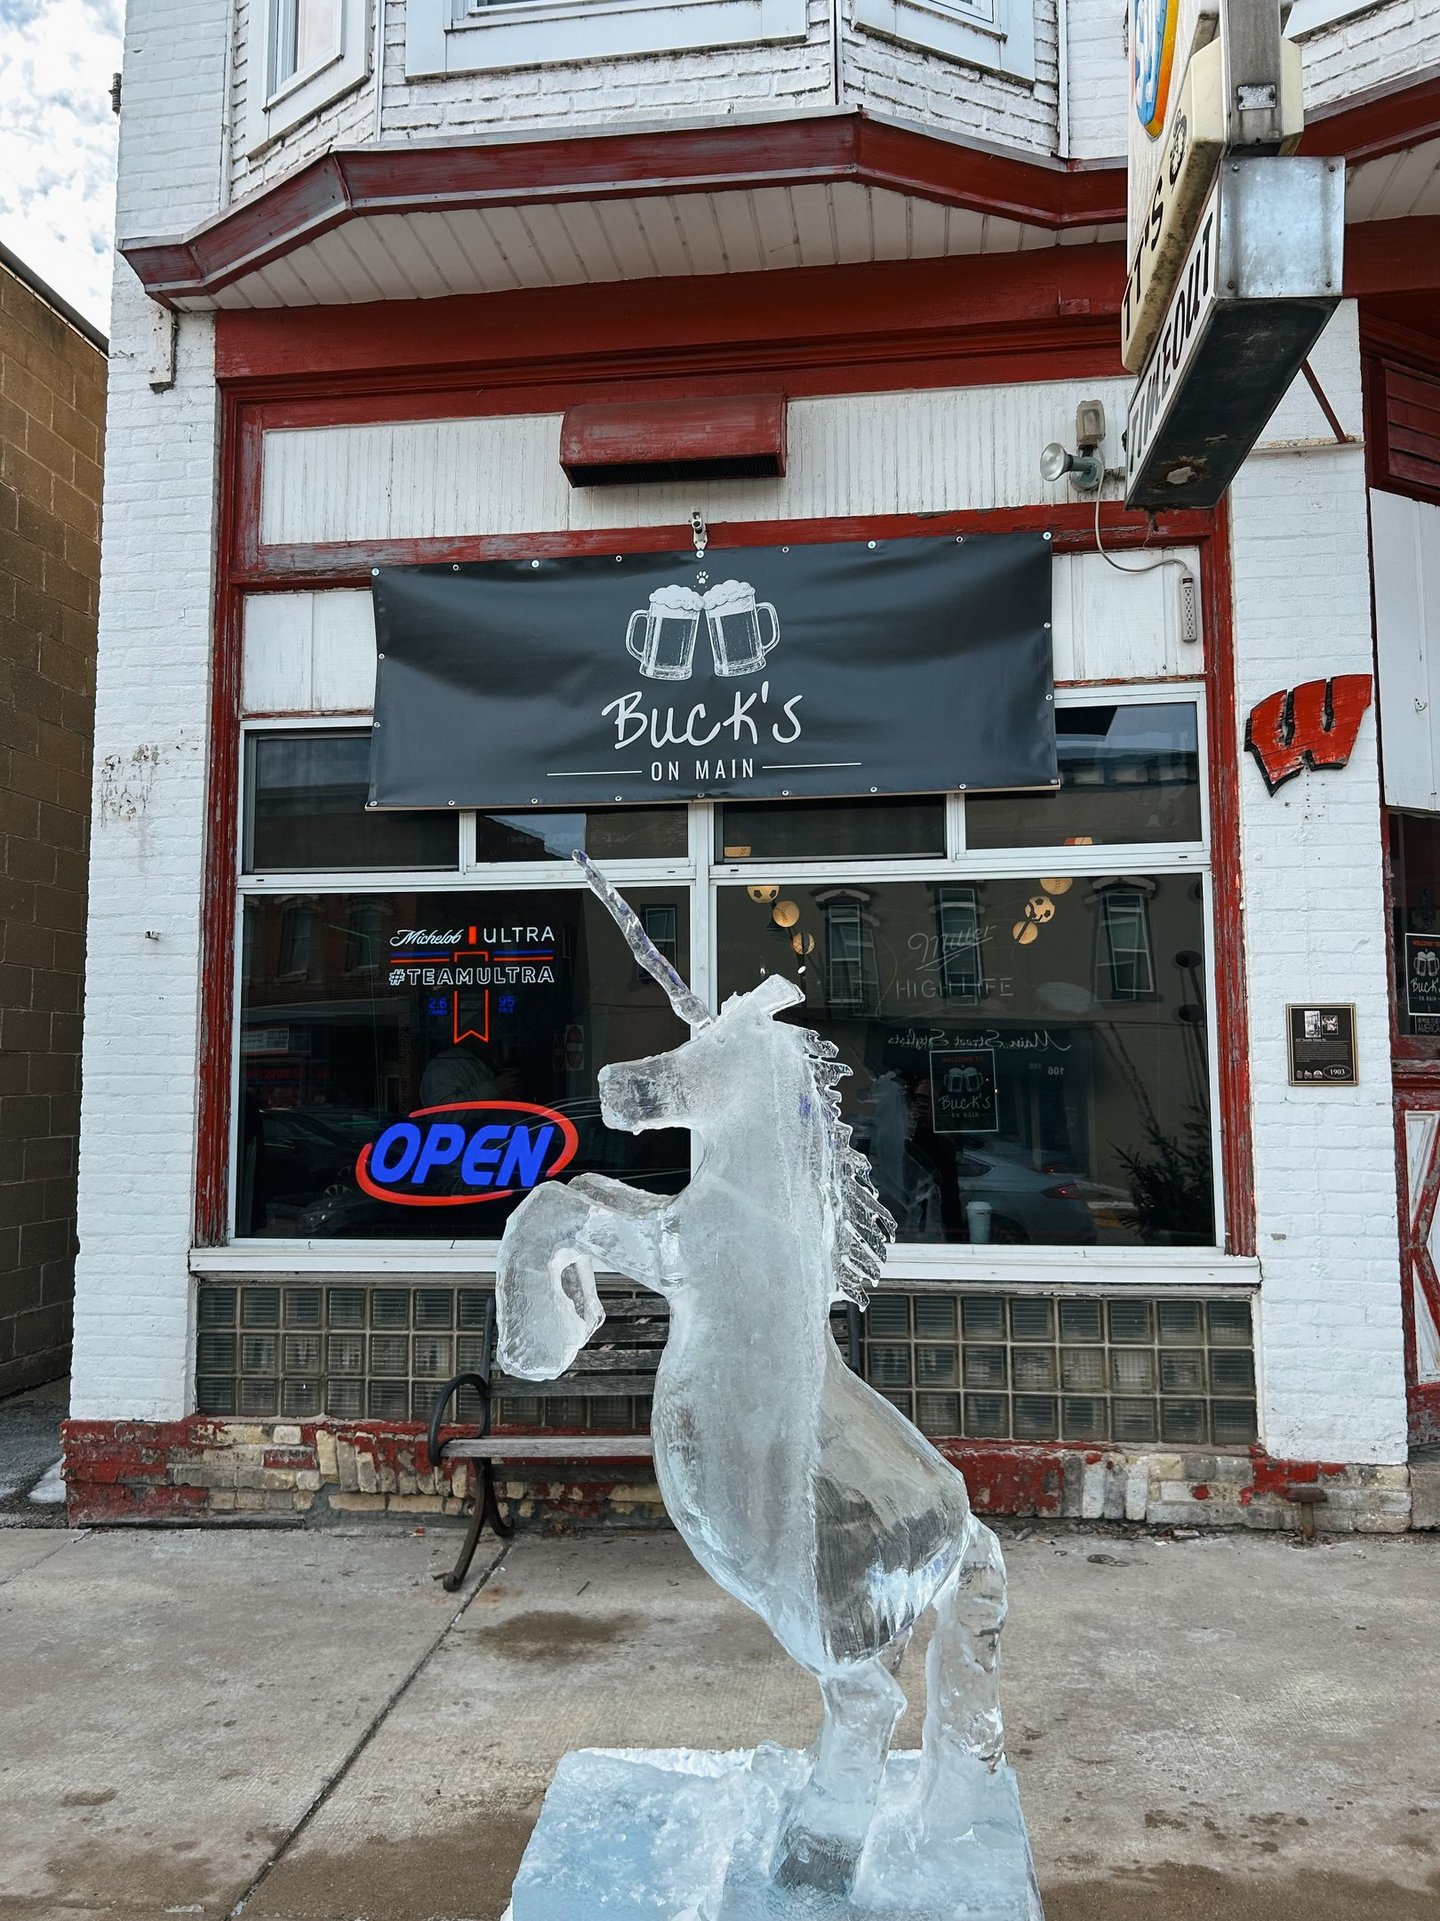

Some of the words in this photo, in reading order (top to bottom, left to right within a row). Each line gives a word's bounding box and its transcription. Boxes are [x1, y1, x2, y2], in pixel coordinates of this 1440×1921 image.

[1129, 211, 1213, 477] TIMEOUT
[651, 761, 680, 781] ON
[695, 758, 754, 780] MAIN
[389, 929, 464, 947] Michelob
[483, 926, 555, 943] ULTRA
[908, 925, 998, 964] Miller
[389, 966, 555, 986] #TEAMULTRA
[896, 979, 951, 999] HIGH
[960, 977, 1013, 998] LIFE
[370, 1122, 555, 1187] OPEN
